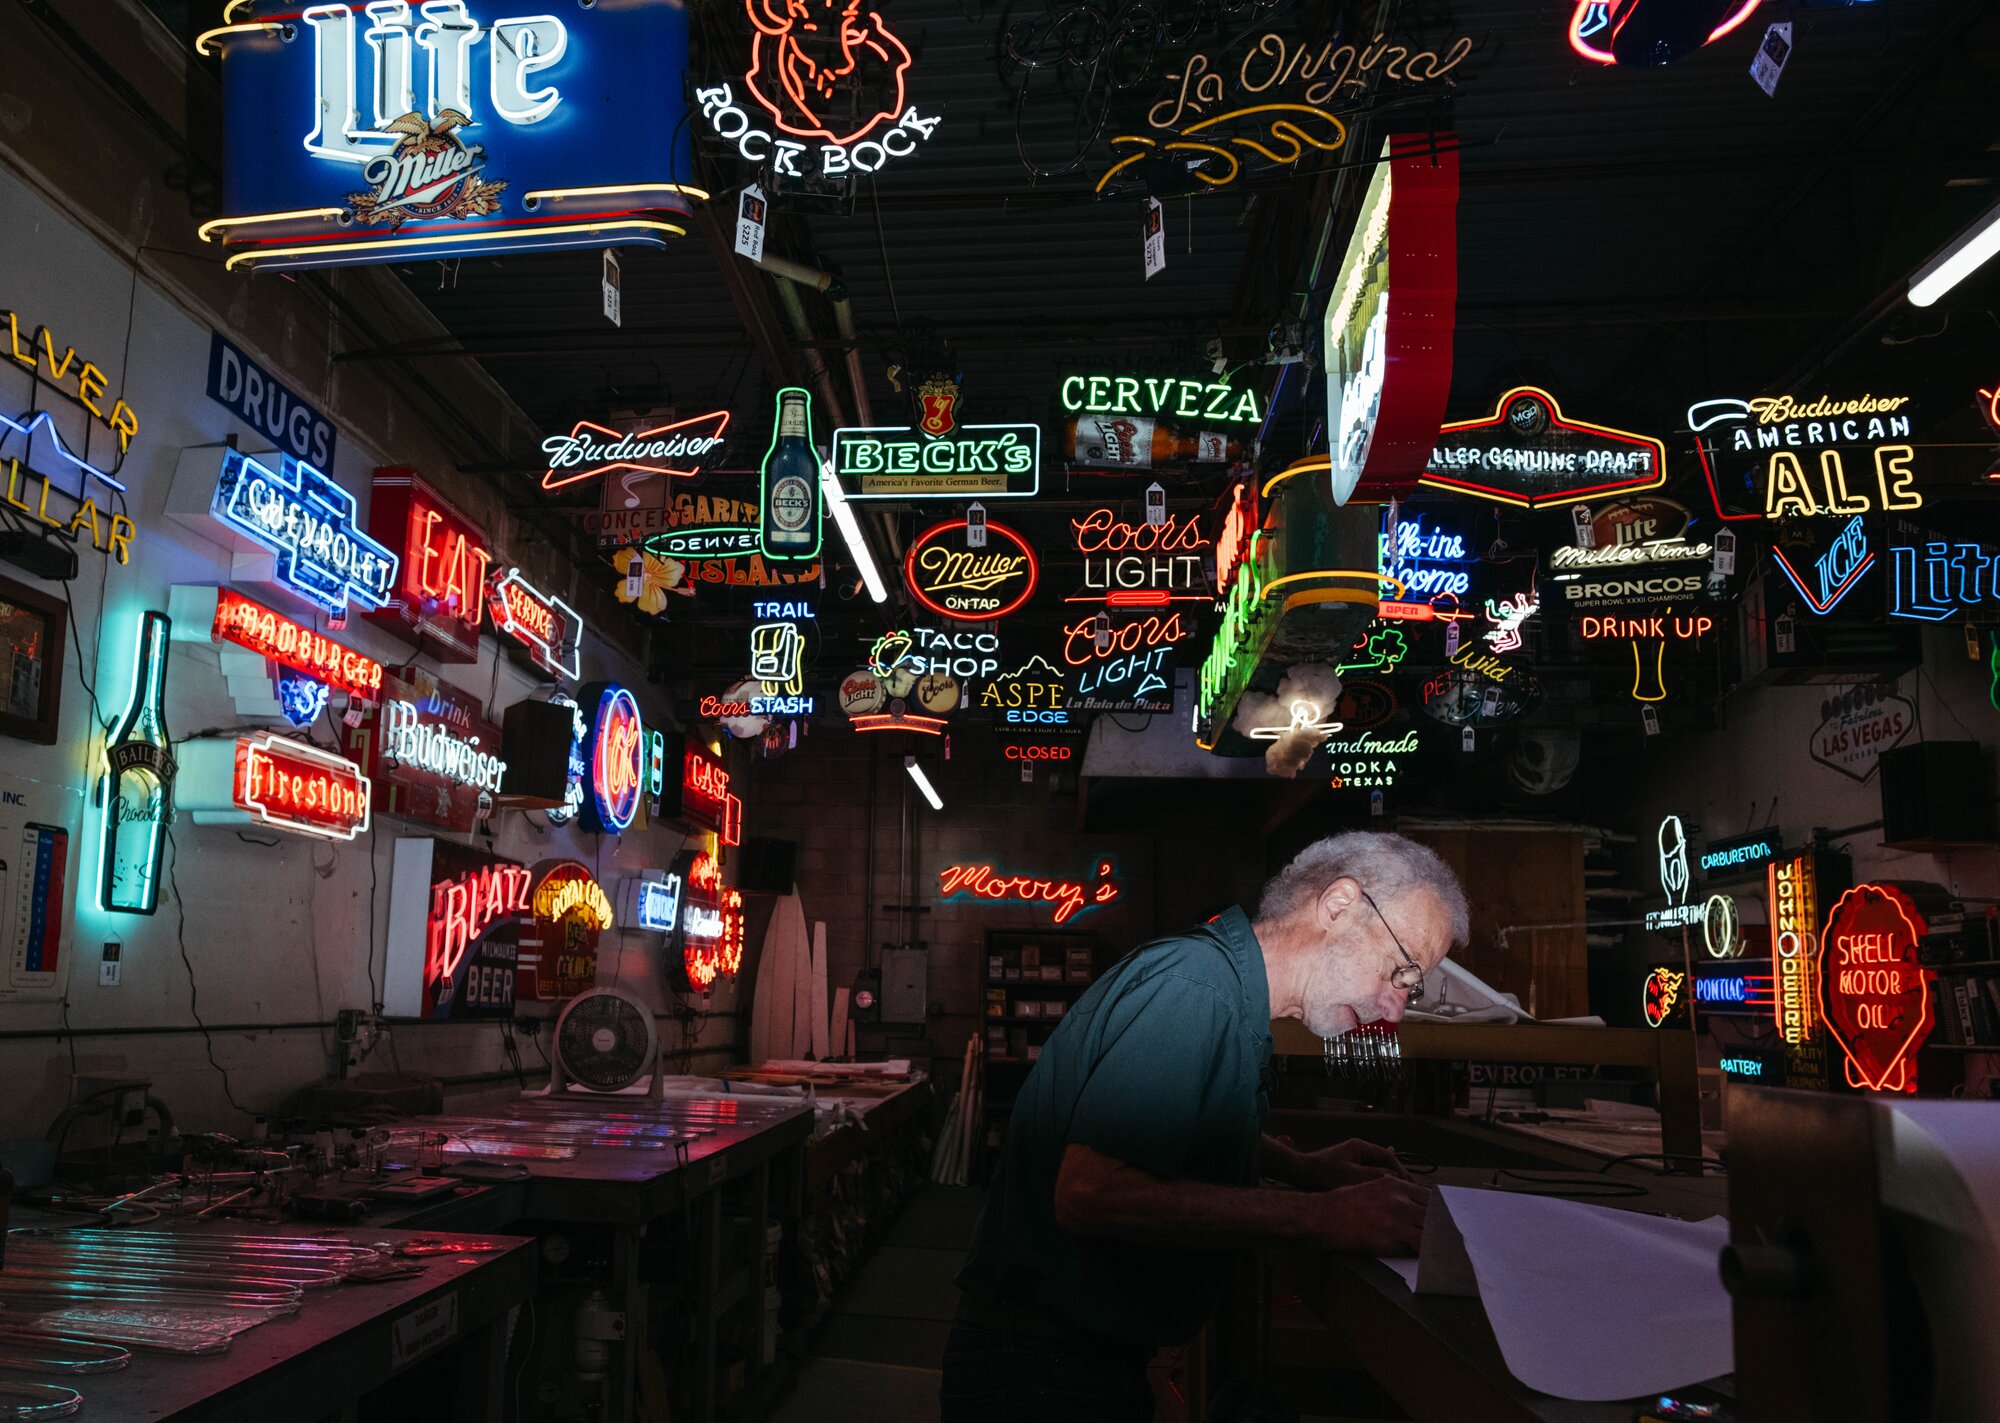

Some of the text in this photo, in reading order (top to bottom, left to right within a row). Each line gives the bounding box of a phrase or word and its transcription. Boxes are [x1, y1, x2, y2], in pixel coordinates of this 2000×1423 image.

[303, 0, 568, 164] Lite
[1148, 33, 1473, 129] La Original
[696, 82, 942, 177] ROCK BOCK
[363, 144, 484, 204] Miller
[418, 206, 441, 214] SINCE
[742, 224, 750, 246] $225
[9, 312, 139, 455] LVER
[1062, 375, 1262, 423] CERVEZA
[219, 343, 330, 469] DRUGS
[1511, 405, 1537, 424] MGD
[1749, 393, 1910, 425] Budweiser
[1099, 421, 1120, 462] LIGHT
[1111, 420, 1137, 464] Coors
[1734, 415, 1911, 451] AMERICAN
[541, 432, 725, 469] Budweiser
[1432, 447, 1652, 473] LLER GENUINE DRAFT
[869, 476, 1003, 487] America's Favorite German Beer.
[1766, 445, 1923, 519] ALE
[6, 457, 137, 566] LLAR
[248, 478, 391, 596] CHEVROLET
[1072, 508, 1210, 551] Coors
[1614, 517, 1657, 548] Lite
[421, 510, 492, 627] EAT
[920, 546, 1027, 586] Miller
[1553, 537, 1713, 569] Miller Time
[1814, 515, 1868, 608] ICE
[1085, 556, 1201, 588] LIGHT
[1565, 575, 1702, 600] BRONCOS
[508, 583, 554, 641] SERVICE
[753, 601, 816, 619] TRAIL
[1385, 605, 1419, 616] OPEN
[1574, 593, 1694, 608] SUPER BOWL XXXII CHAMPIONS
[238, 601, 383, 690] HAMBURGER
[913, 627, 999, 653] TACO
[1064, 612, 1187, 665] Coors
[909, 655, 998, 678] SHOP
[1079, 646, 1173, 693] LIGHT
[1450, 640, 1513, 683] Wild
[700, 695, 751, 717] Coors
[750, 696, 814, 714] STASH
[845, 688, 875, 707] LIGHT
[921, 679, 954, 704] Coors
[980, 682, 1064, 709] ASPE
[1066, 696, 1171, 711] La Bala de Plata
[428, 690, 472, 729] Drink
[1006, 710, 1069, 724] EDGE
[1840, 706, 1885, 731] Fabulous
[396, 699, 507, 794] Budweiser
[1325, 730, 1419, 754] andmade
[1821, 712, 1904, 758] LAS VEGAS
[118, 745, 175, 777] BAILEYS
[608, 716, 638, 795] OK
[1005, 745, 1071, 760] CLOSED
[251, 752, 367, 820] Firestone
[692, 754, 730, 802] CASE
[1342, 776, 1393, 787] TEXAS
[2, 790, 27, 807] INC.
[1701, 842, 1772, 870] CARBURETION
[552, 879, 584, 923] ROYAL
[940, 864, 1118, 924] Morry's
[442, 868, 532, 978] BLATZ
[481, 940, 517, 958] MILWAUKEE
[1777, 863, 1801, 1045] JOHN DEERE
[1837, 933, 1901, 965] SHELL
[466, 964, 514, 1007] BEER
[1696, 976, 1745, 1002] PONTIAC
[1839, 970, 1902, 997] MOTOR
[1857, 1004, 1889, 1029] OIL
[1720, 1058, 1763, 1076] BATTERY
